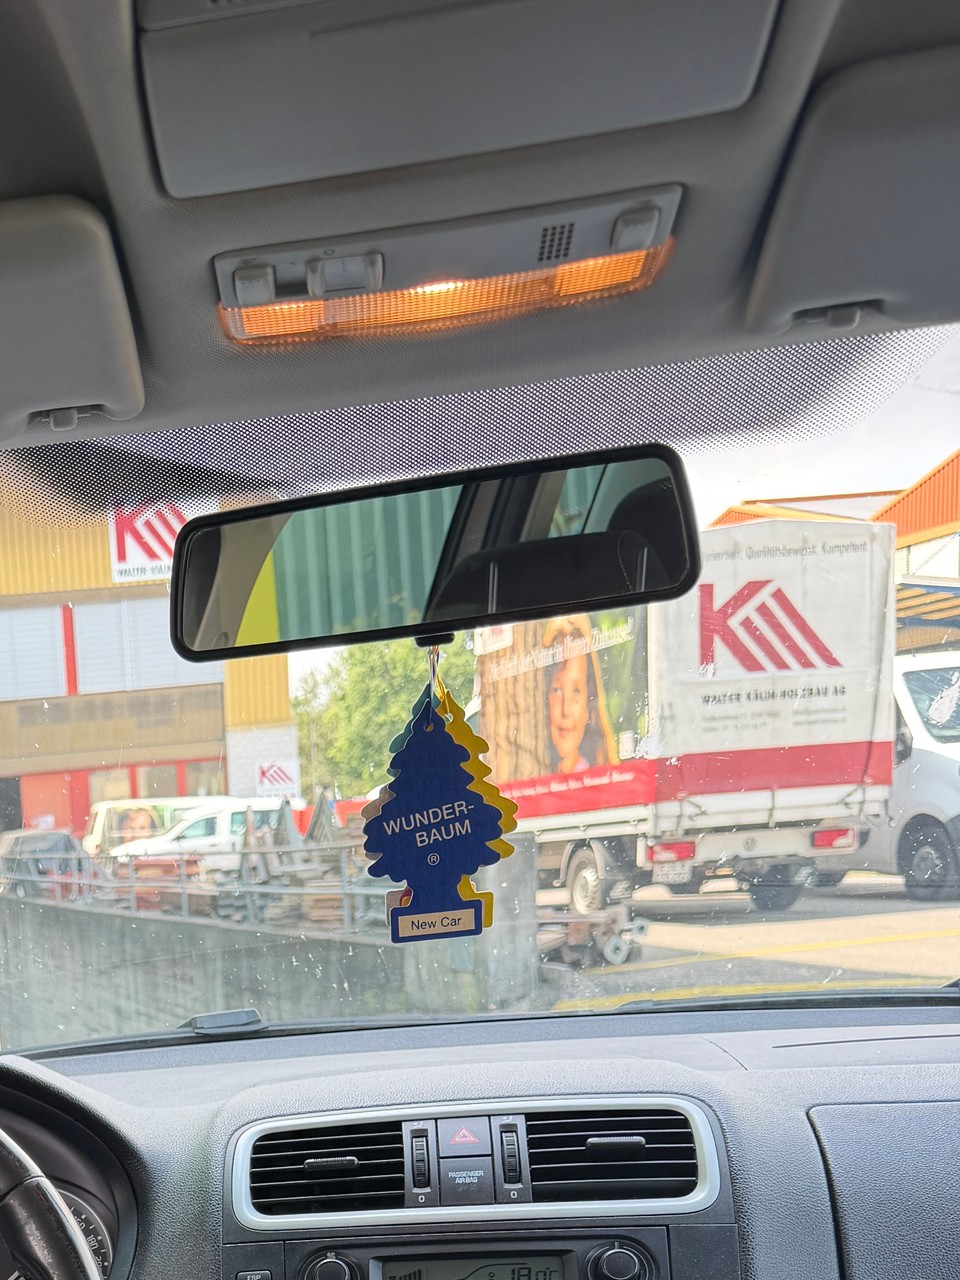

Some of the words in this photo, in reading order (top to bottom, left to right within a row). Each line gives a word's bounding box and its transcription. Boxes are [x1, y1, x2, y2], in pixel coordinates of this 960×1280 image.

[383, 800, 475, 836] WUNDER-
[415, 819, 472, 848] BAUM
[411, 919, 437, 931] New
[440, 916, 462, 928] Car
[448, 1170, 484, 1178] PASSENGER
[86, 1234, 99, 1250] 180
